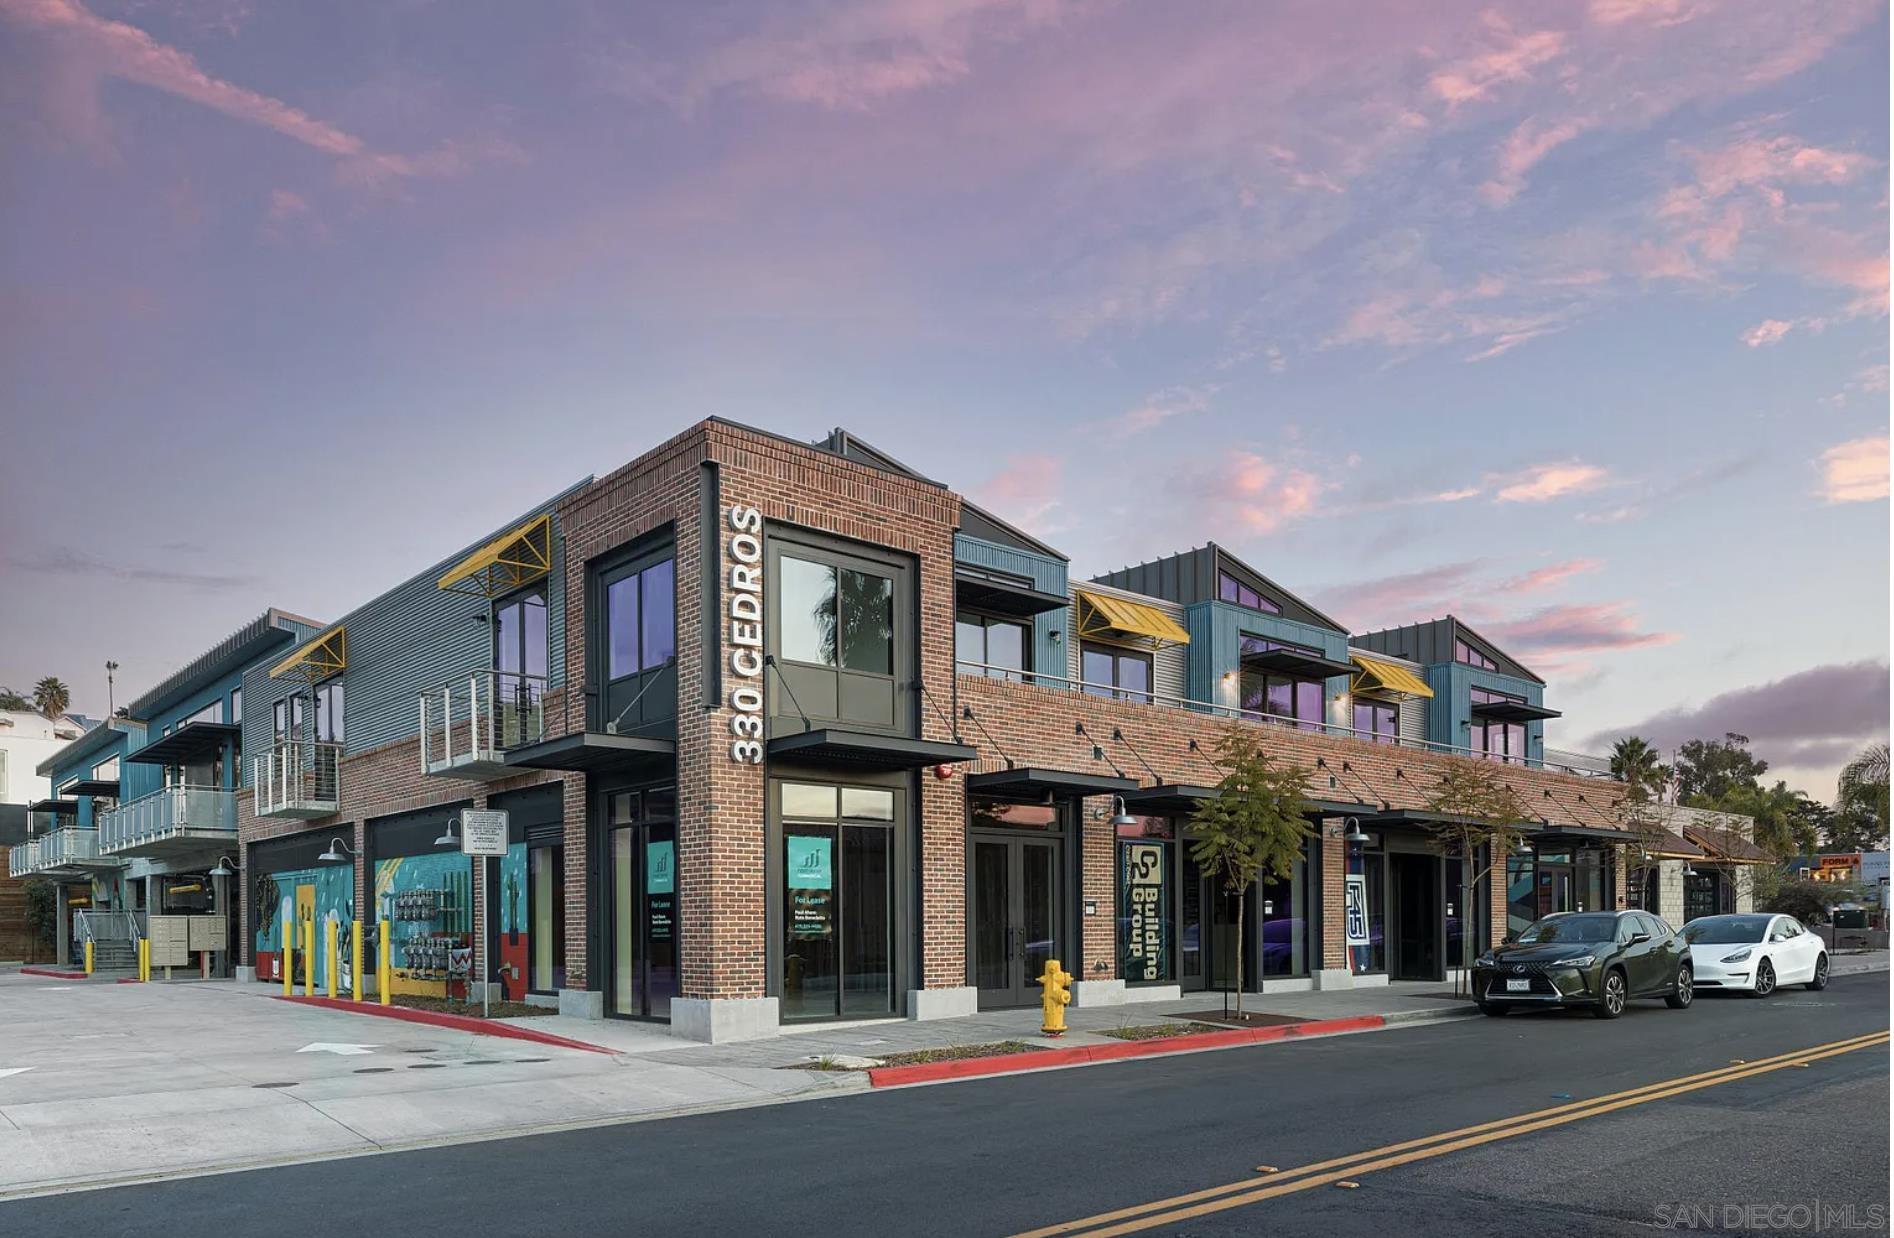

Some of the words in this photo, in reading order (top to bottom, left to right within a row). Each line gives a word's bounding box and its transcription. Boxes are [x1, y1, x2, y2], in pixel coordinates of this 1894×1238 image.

[729, 505, 762, 678] CEDROS
[730, 687, 763, 764] 330
[807, 895, 826, 905] Lease
[1129, 888, 1144, 957] Group
[1144, 888, 1159, 980] Building
[1346, 881, 1367, 939] F45
